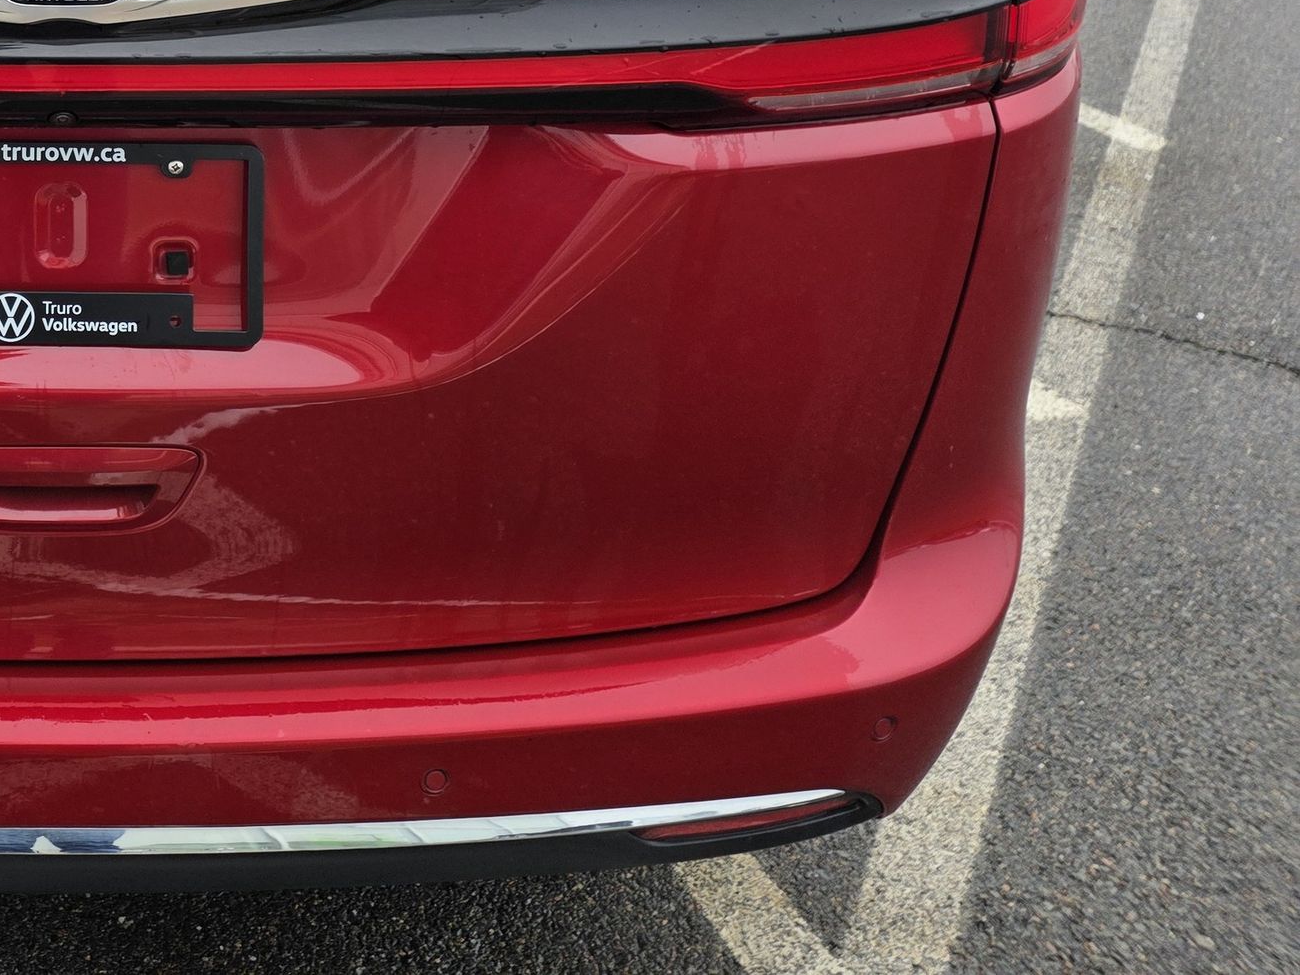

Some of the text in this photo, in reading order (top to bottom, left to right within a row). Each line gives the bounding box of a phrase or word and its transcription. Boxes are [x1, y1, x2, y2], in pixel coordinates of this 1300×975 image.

[1, 143, 127, 162] trurovw.ca
[42, 300, 82, 315] Truro
[42, 317, 138, 335] Volkswagen
